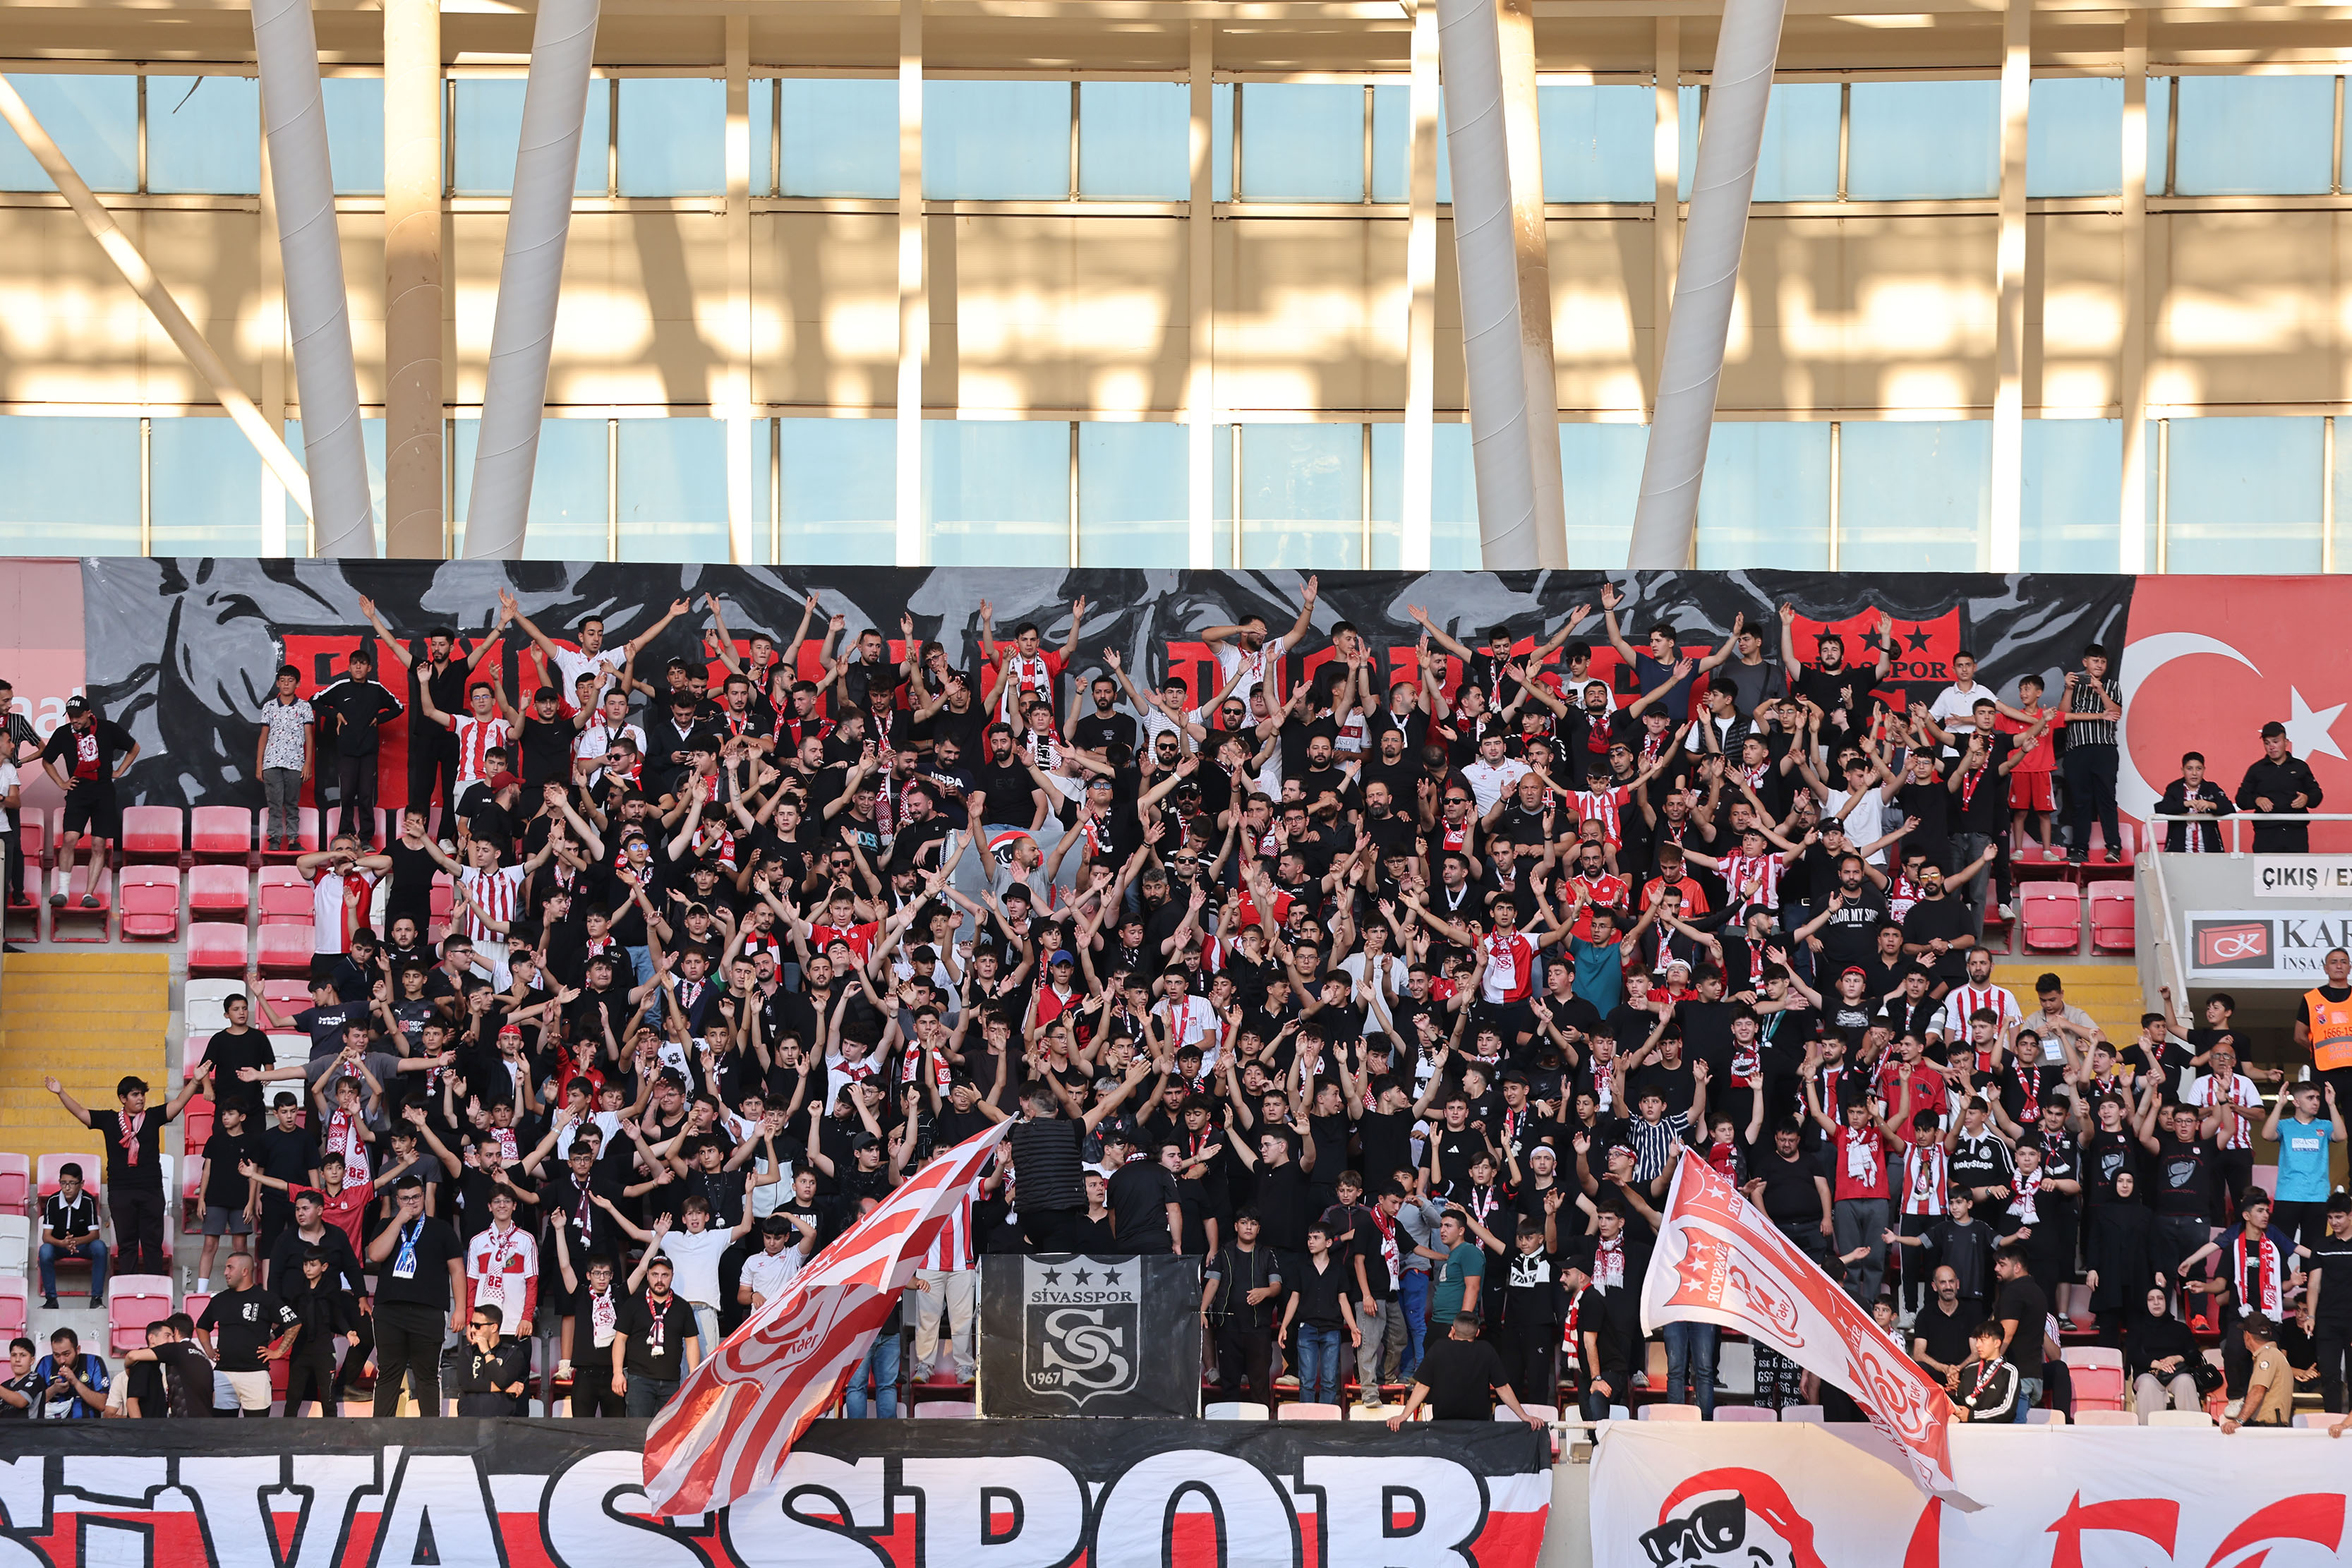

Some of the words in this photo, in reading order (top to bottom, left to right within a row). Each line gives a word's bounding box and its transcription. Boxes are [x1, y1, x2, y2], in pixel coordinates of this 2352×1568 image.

[2262, 867, 2318, 891] ÇIKIŞ
[1850, 907, 1863, 922] MY
[1031, 1288, 1133, 1303] SİVASSPOR
[1031, 1372, 1061, 1385] 1967
